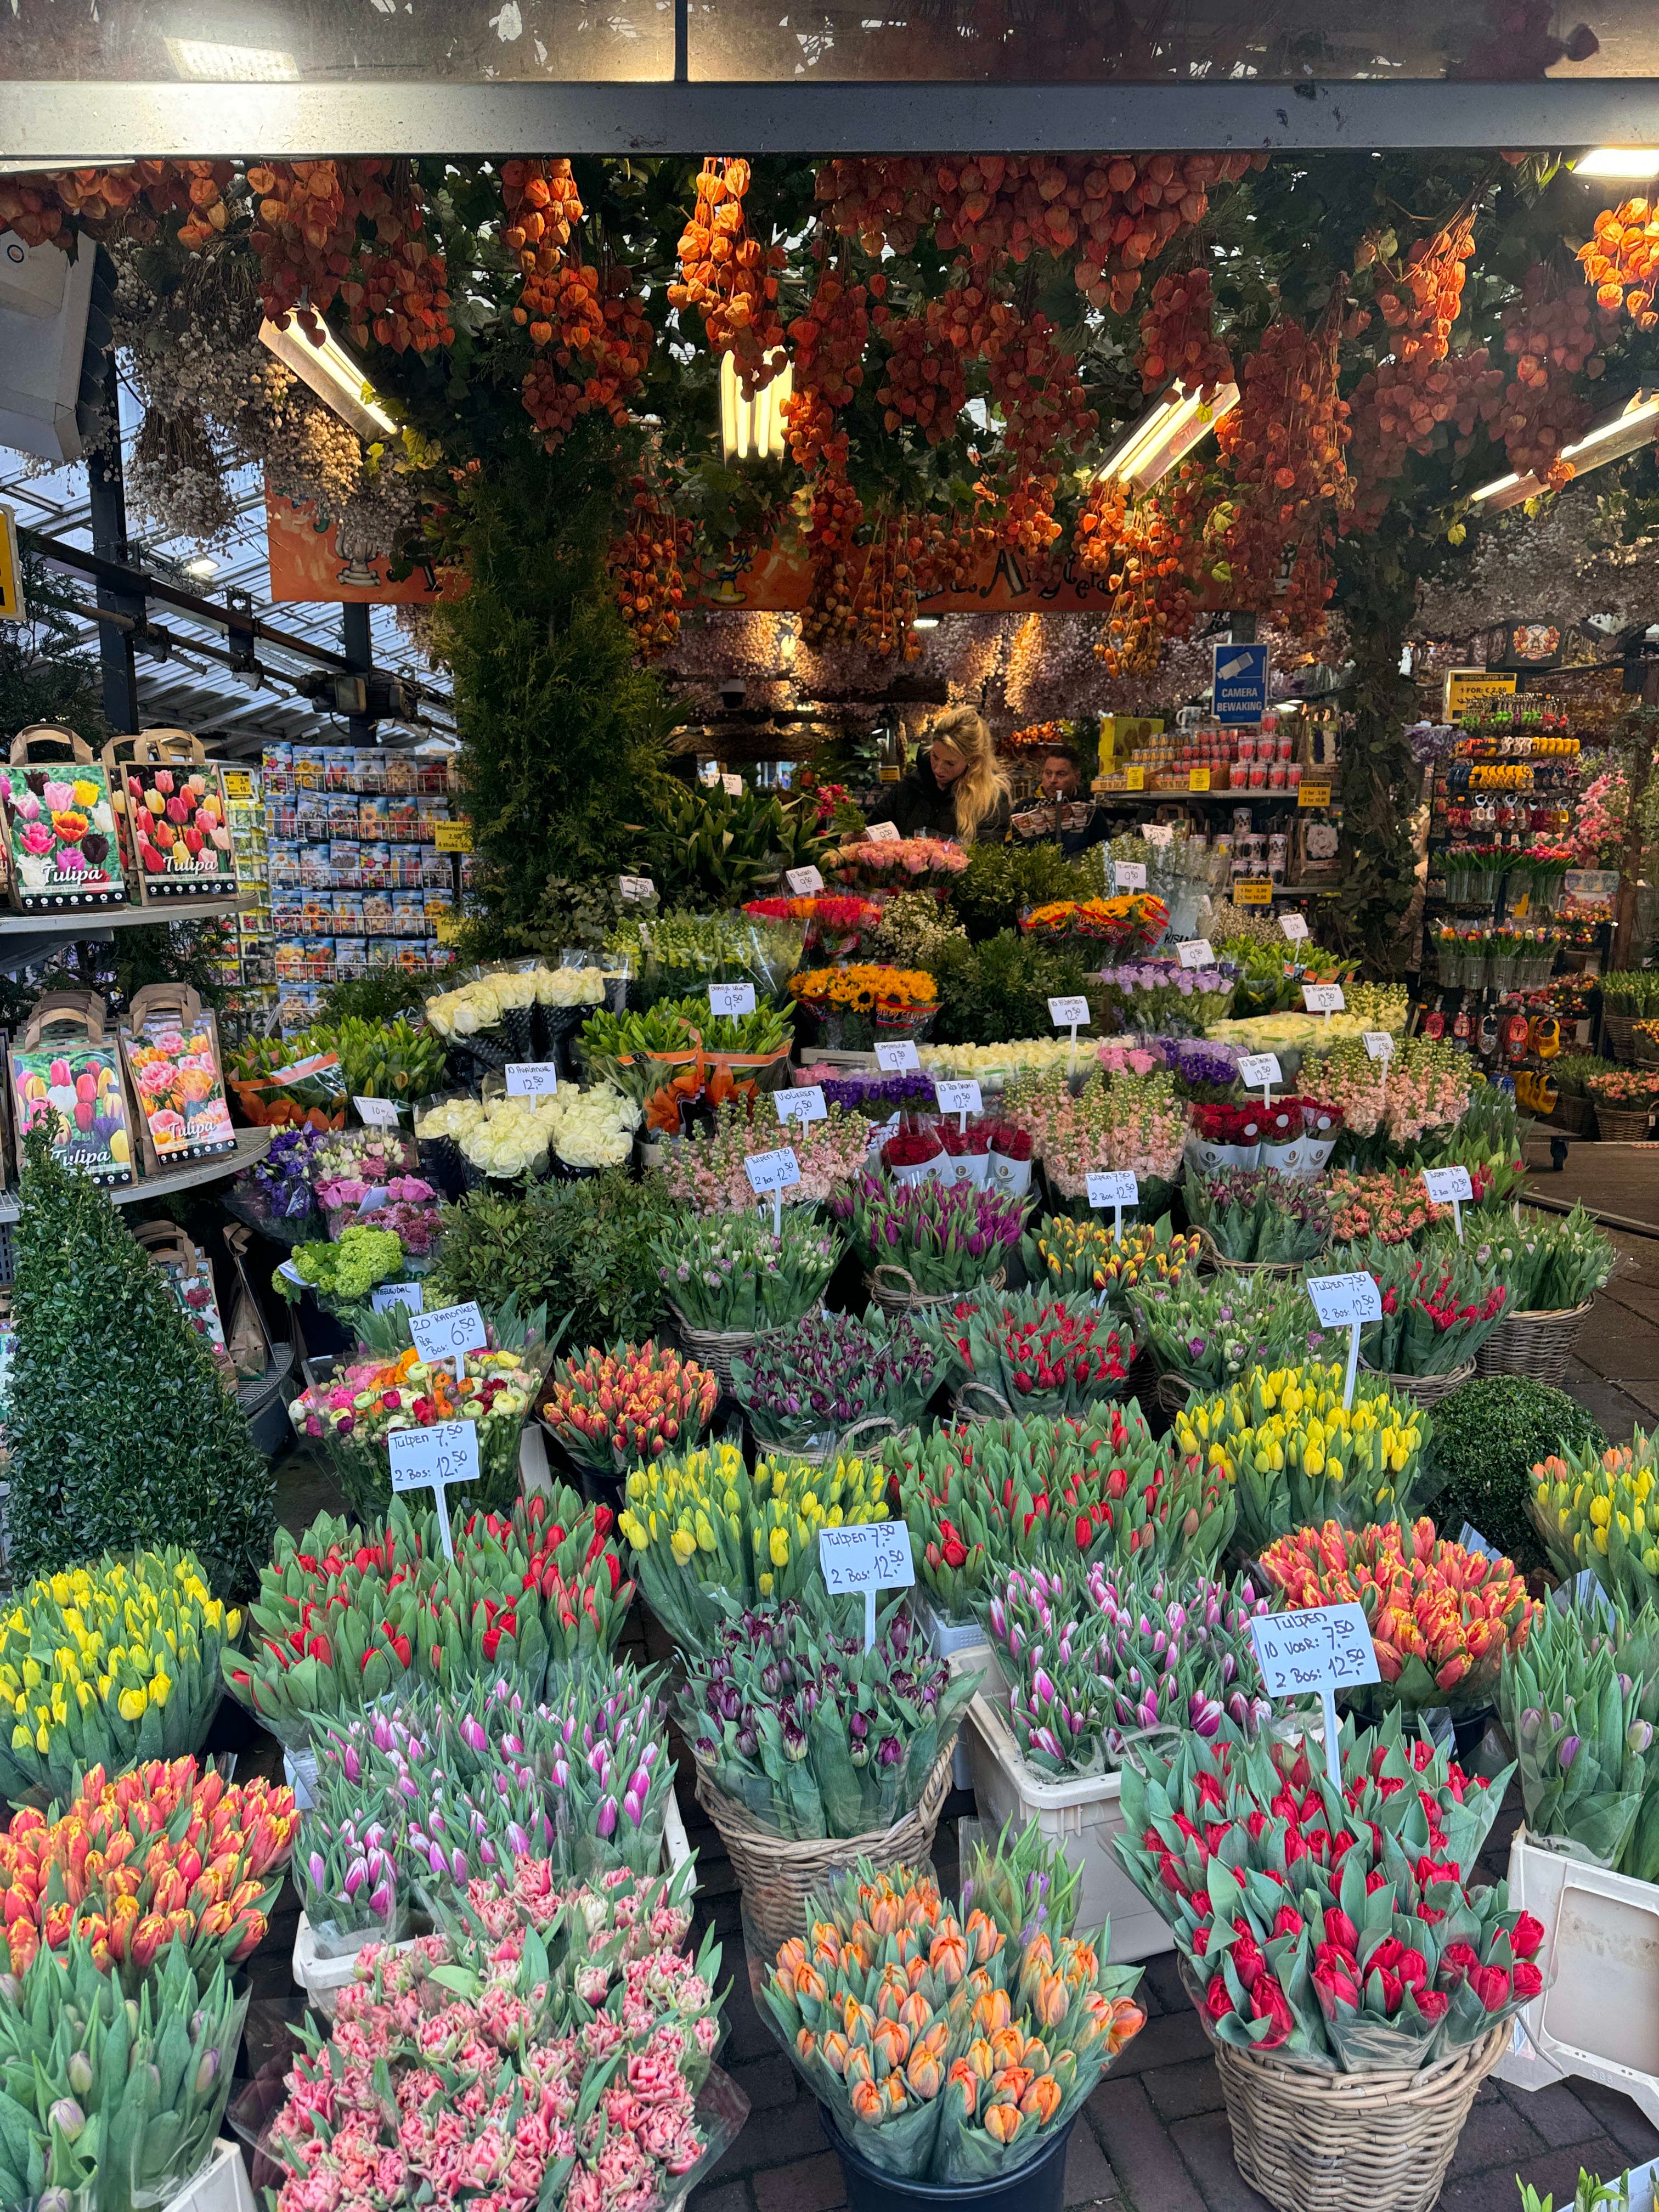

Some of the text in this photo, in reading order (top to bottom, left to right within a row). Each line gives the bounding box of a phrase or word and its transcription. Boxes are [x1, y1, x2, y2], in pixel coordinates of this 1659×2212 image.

[1222, 688, 1257, 697] CAMERA
[1217, 702, 1262, 712] BEWAKING
[162, 856, 217, 874] Tulipa
[40, 866, 103, 885] Tulipa
[725, 994, 743, 1010] 9,50
[1318, 992, 1334, 1007] 12,50
[1065, 1007, 1081, 1021] 12,50
[889, 1051, 905, 1067] 9,50
[1254, 1066, 1271, 1081] 12,50
[523, 1076, 544, 1090] 12,50
[794, 1100, 812, 1116] 6,50
[953, 1093, 970, 1108] 12,50
[168, 1121, 216, 1139] Tulipa
[755, 1176, 761, 1184] 2
[777, 1161, 794, 1181] 12,50
[1116, 1183, 1135, 1199] 12,50
[1452, 1178, 1467, 1193] 12,50
[1343, 1274, 1366, 1291] 7,50
[1322, 1308, 1330, 1321] 2
[1352, 1295, 1374, 1316] 12,50
[413, 1304, 477, 1331] 20 RANONKEL
[416, 1317, 476, 1347] PER 6,50
[432, 1424, 463, 1447] 7,50
[394, 1469, 403, 1481] 2
[436, 1450, 467, 1478] 12,50
[866, 1525, 895, 1548] 7,50
[831, 1569, 843, 1584] 2
[874, 1550, 904, 1579] 12,50
[1265, 1641, 1278, 1659] 10
[1322, 1620, 1355, 1650] 7,50
[1275, 1672, 1286, 1688] 2
[1328, 1648, 1366, 1678] 12,50
